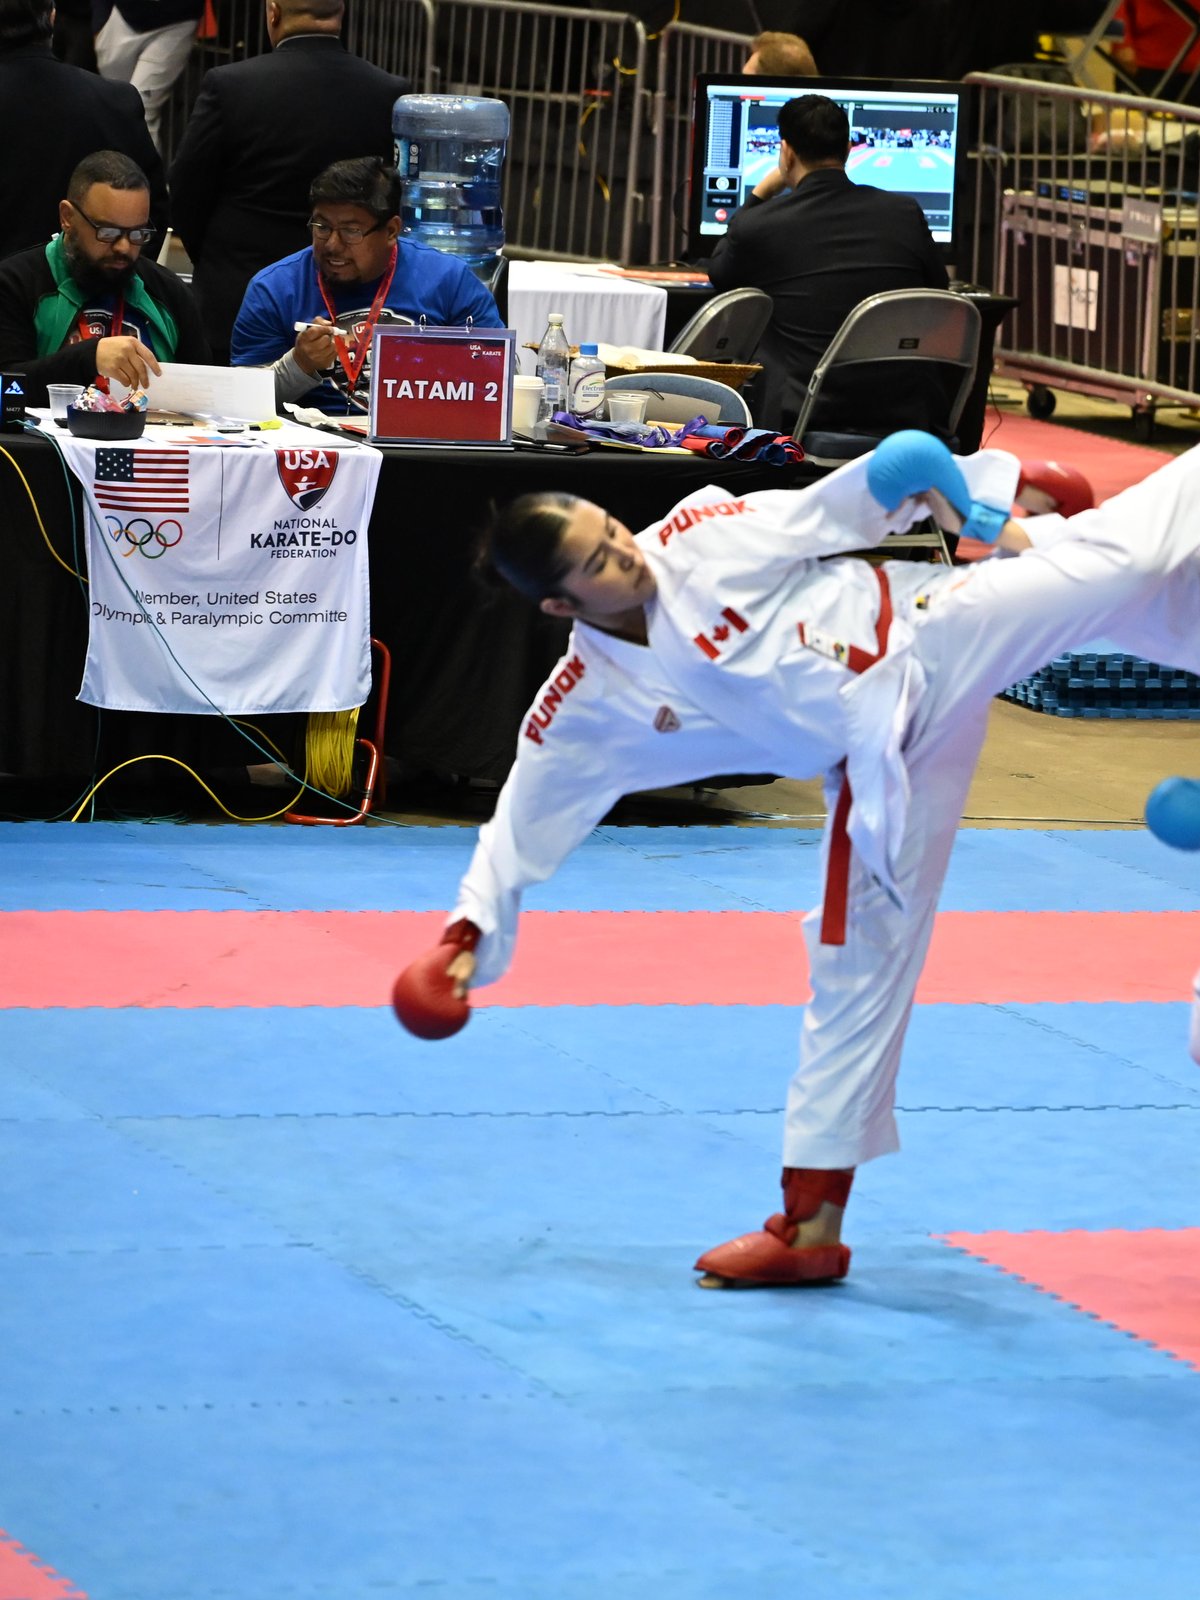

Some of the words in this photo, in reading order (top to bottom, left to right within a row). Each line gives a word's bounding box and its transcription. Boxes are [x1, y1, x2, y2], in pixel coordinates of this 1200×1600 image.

[383, 379, 475, 401] TATAMI
[484, 381, 498, 402] 2
[283, 450, 331, 470] USA
[274, 518, 338, 530] NATIONAL
[658, 500, 756, 547] PUNOK
[250, 530, 357, 549] KARATE-DO
[270, 549, 337, 559] FEDERATION
[206, 591, 259, 606] United
[264, 590, 318, 605] States
[156, 611, 167, 625] &
[171, 610, 264, 628] Paralympic
[525, 654, 585, 746] PUNOK
